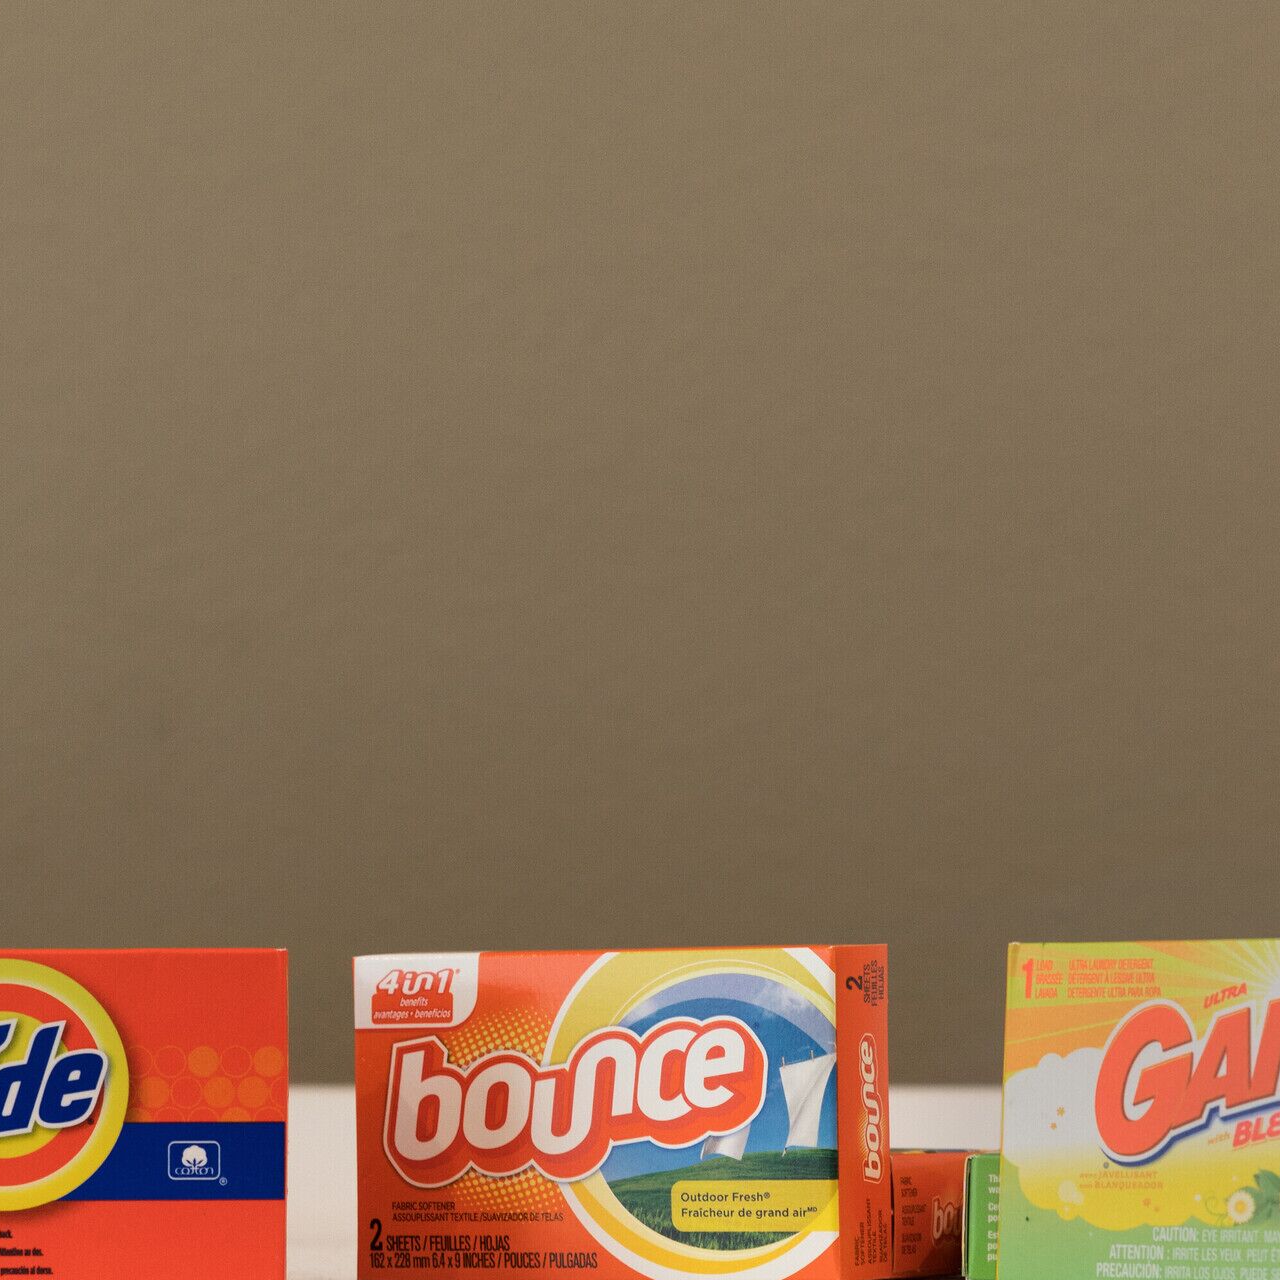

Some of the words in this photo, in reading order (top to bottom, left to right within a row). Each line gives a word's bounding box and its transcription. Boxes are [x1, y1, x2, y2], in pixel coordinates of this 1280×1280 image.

[846, 976, 863, 990] 2
[1022, 958, 1033, 1000] 1
[400, 997, 428, 1007] benefits
[1203, 983, 1248, 1009] ULTRA
[374, 1010, 409, 1020] avantages
[415, 1008, 451, 1018] beneficios
[392, 1026, 747, 1163] bounce
[860, 1040, 881, 1179] bounce
[681, 1192, 728, 1202] Outdoor
[392, 1202, 418, 1211] FABRIC
[419, 1202, 456, 1211] SOFTENER
[681, 1208, 734, 1217] Fraîcheur
[738, 1208, 752, 1217] de
[756, 1208, 789, 1219] grand
[392, 1213, 450, 1222] ASSOUPLISSANT
[451, 1213, 478, 1222] TEXTILE
[530, 1213, 539, 1222] DE
[541, 1213, 564, 1222] TELAS
[370, 1218, 383, 1251] 2
[386, 1236, 421, 1251] SHEETS
[430, 1236, 471, 1251] FEUILLES
[479, 1236, 510, 1251] HOJAS
[1152, 1227, 1199, 1242] CAUTION:
[370, 1253, 386, 1268] 162
[387, 1257, 393, 1268] x
[394, 1253, 411, 1268] 228
[413, 1257, 430, 1268] mm
[447, 1257, 453, 1268] x
[454, 1253, 461, 1268] 9
[463, 1253, 495, 1268] INCHES
[504, 1253, 540, 1268] POUCES
[549, 1253, 597, 1268] PULGADAS
[1096, 1262, 1162, 1279] PRECAUCIÓN:
